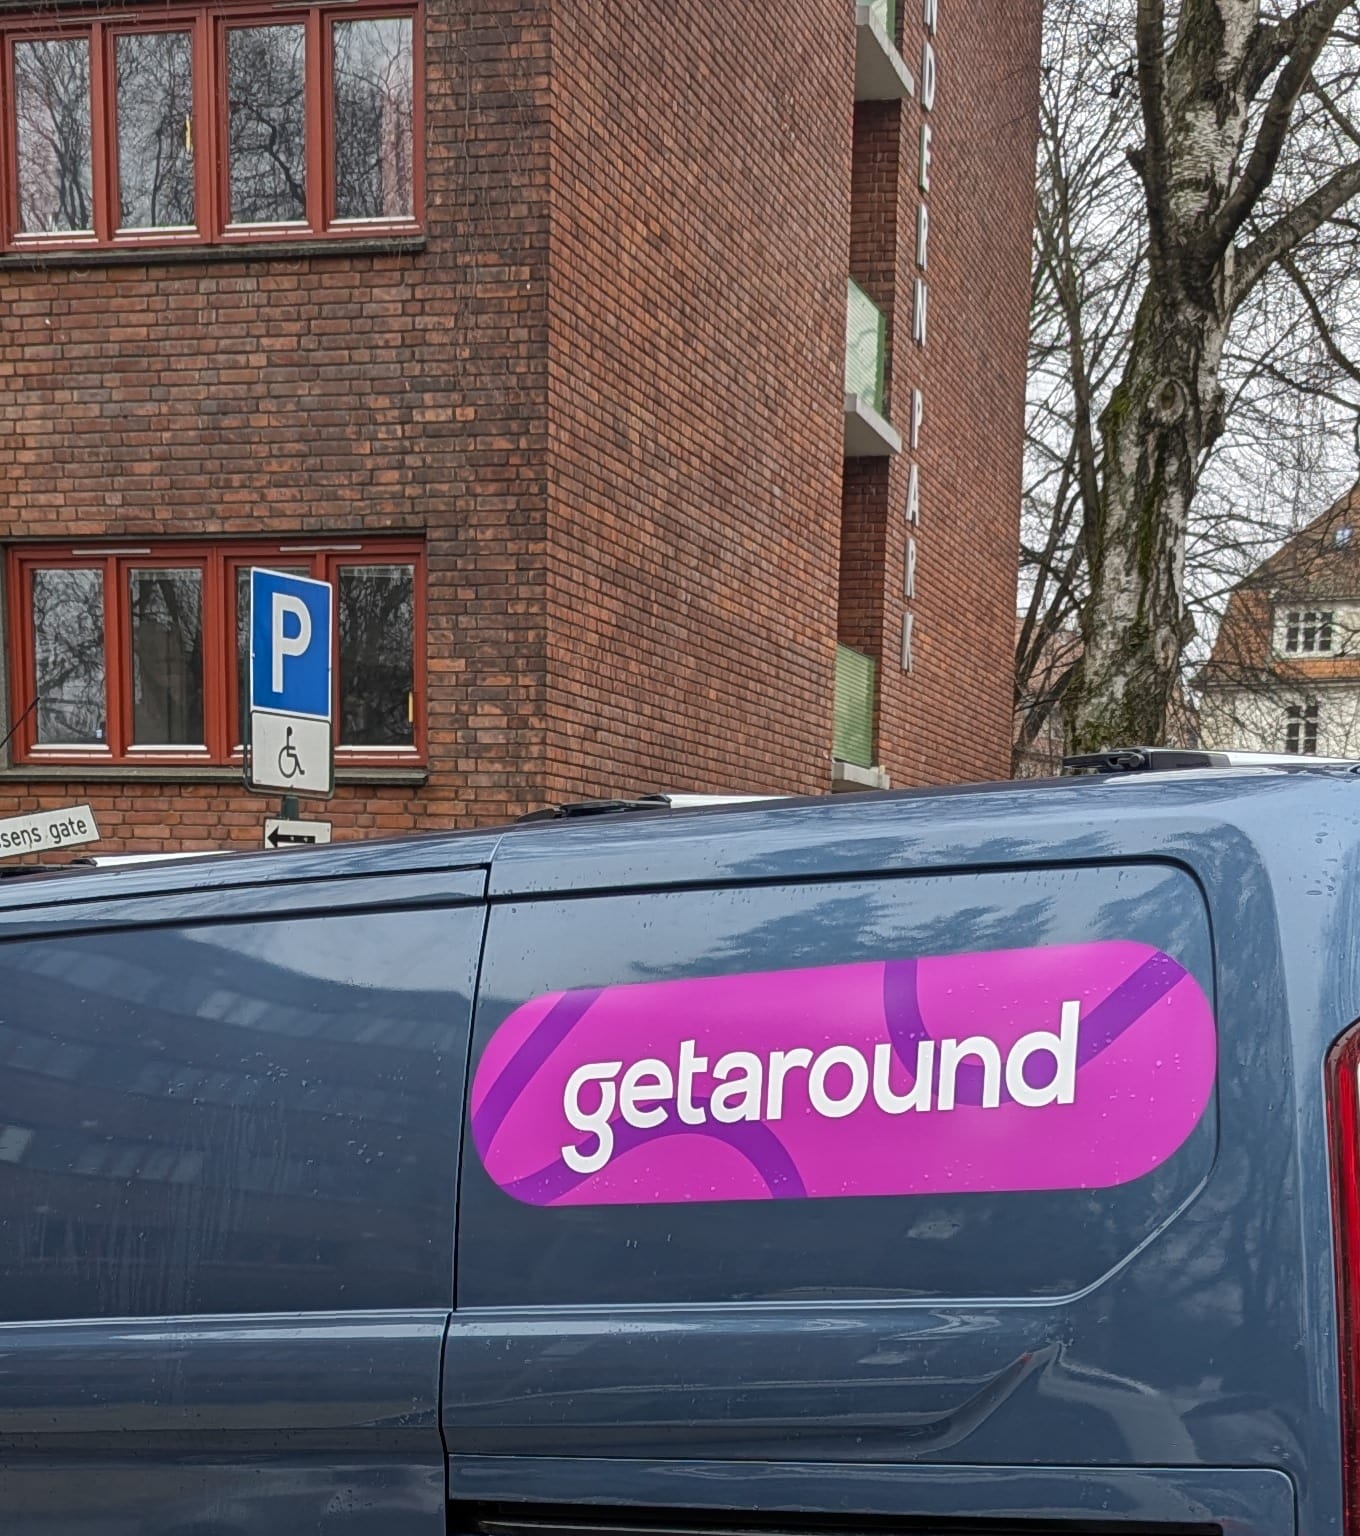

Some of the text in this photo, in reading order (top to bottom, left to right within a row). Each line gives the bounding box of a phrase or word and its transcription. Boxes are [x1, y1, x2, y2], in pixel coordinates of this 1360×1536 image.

[902, 388, 923, 674] PARK
[270, 591, 312, 693] P
[48, 817, 88, 844] gate
[560, 1000, 1081, 1175] getaround
